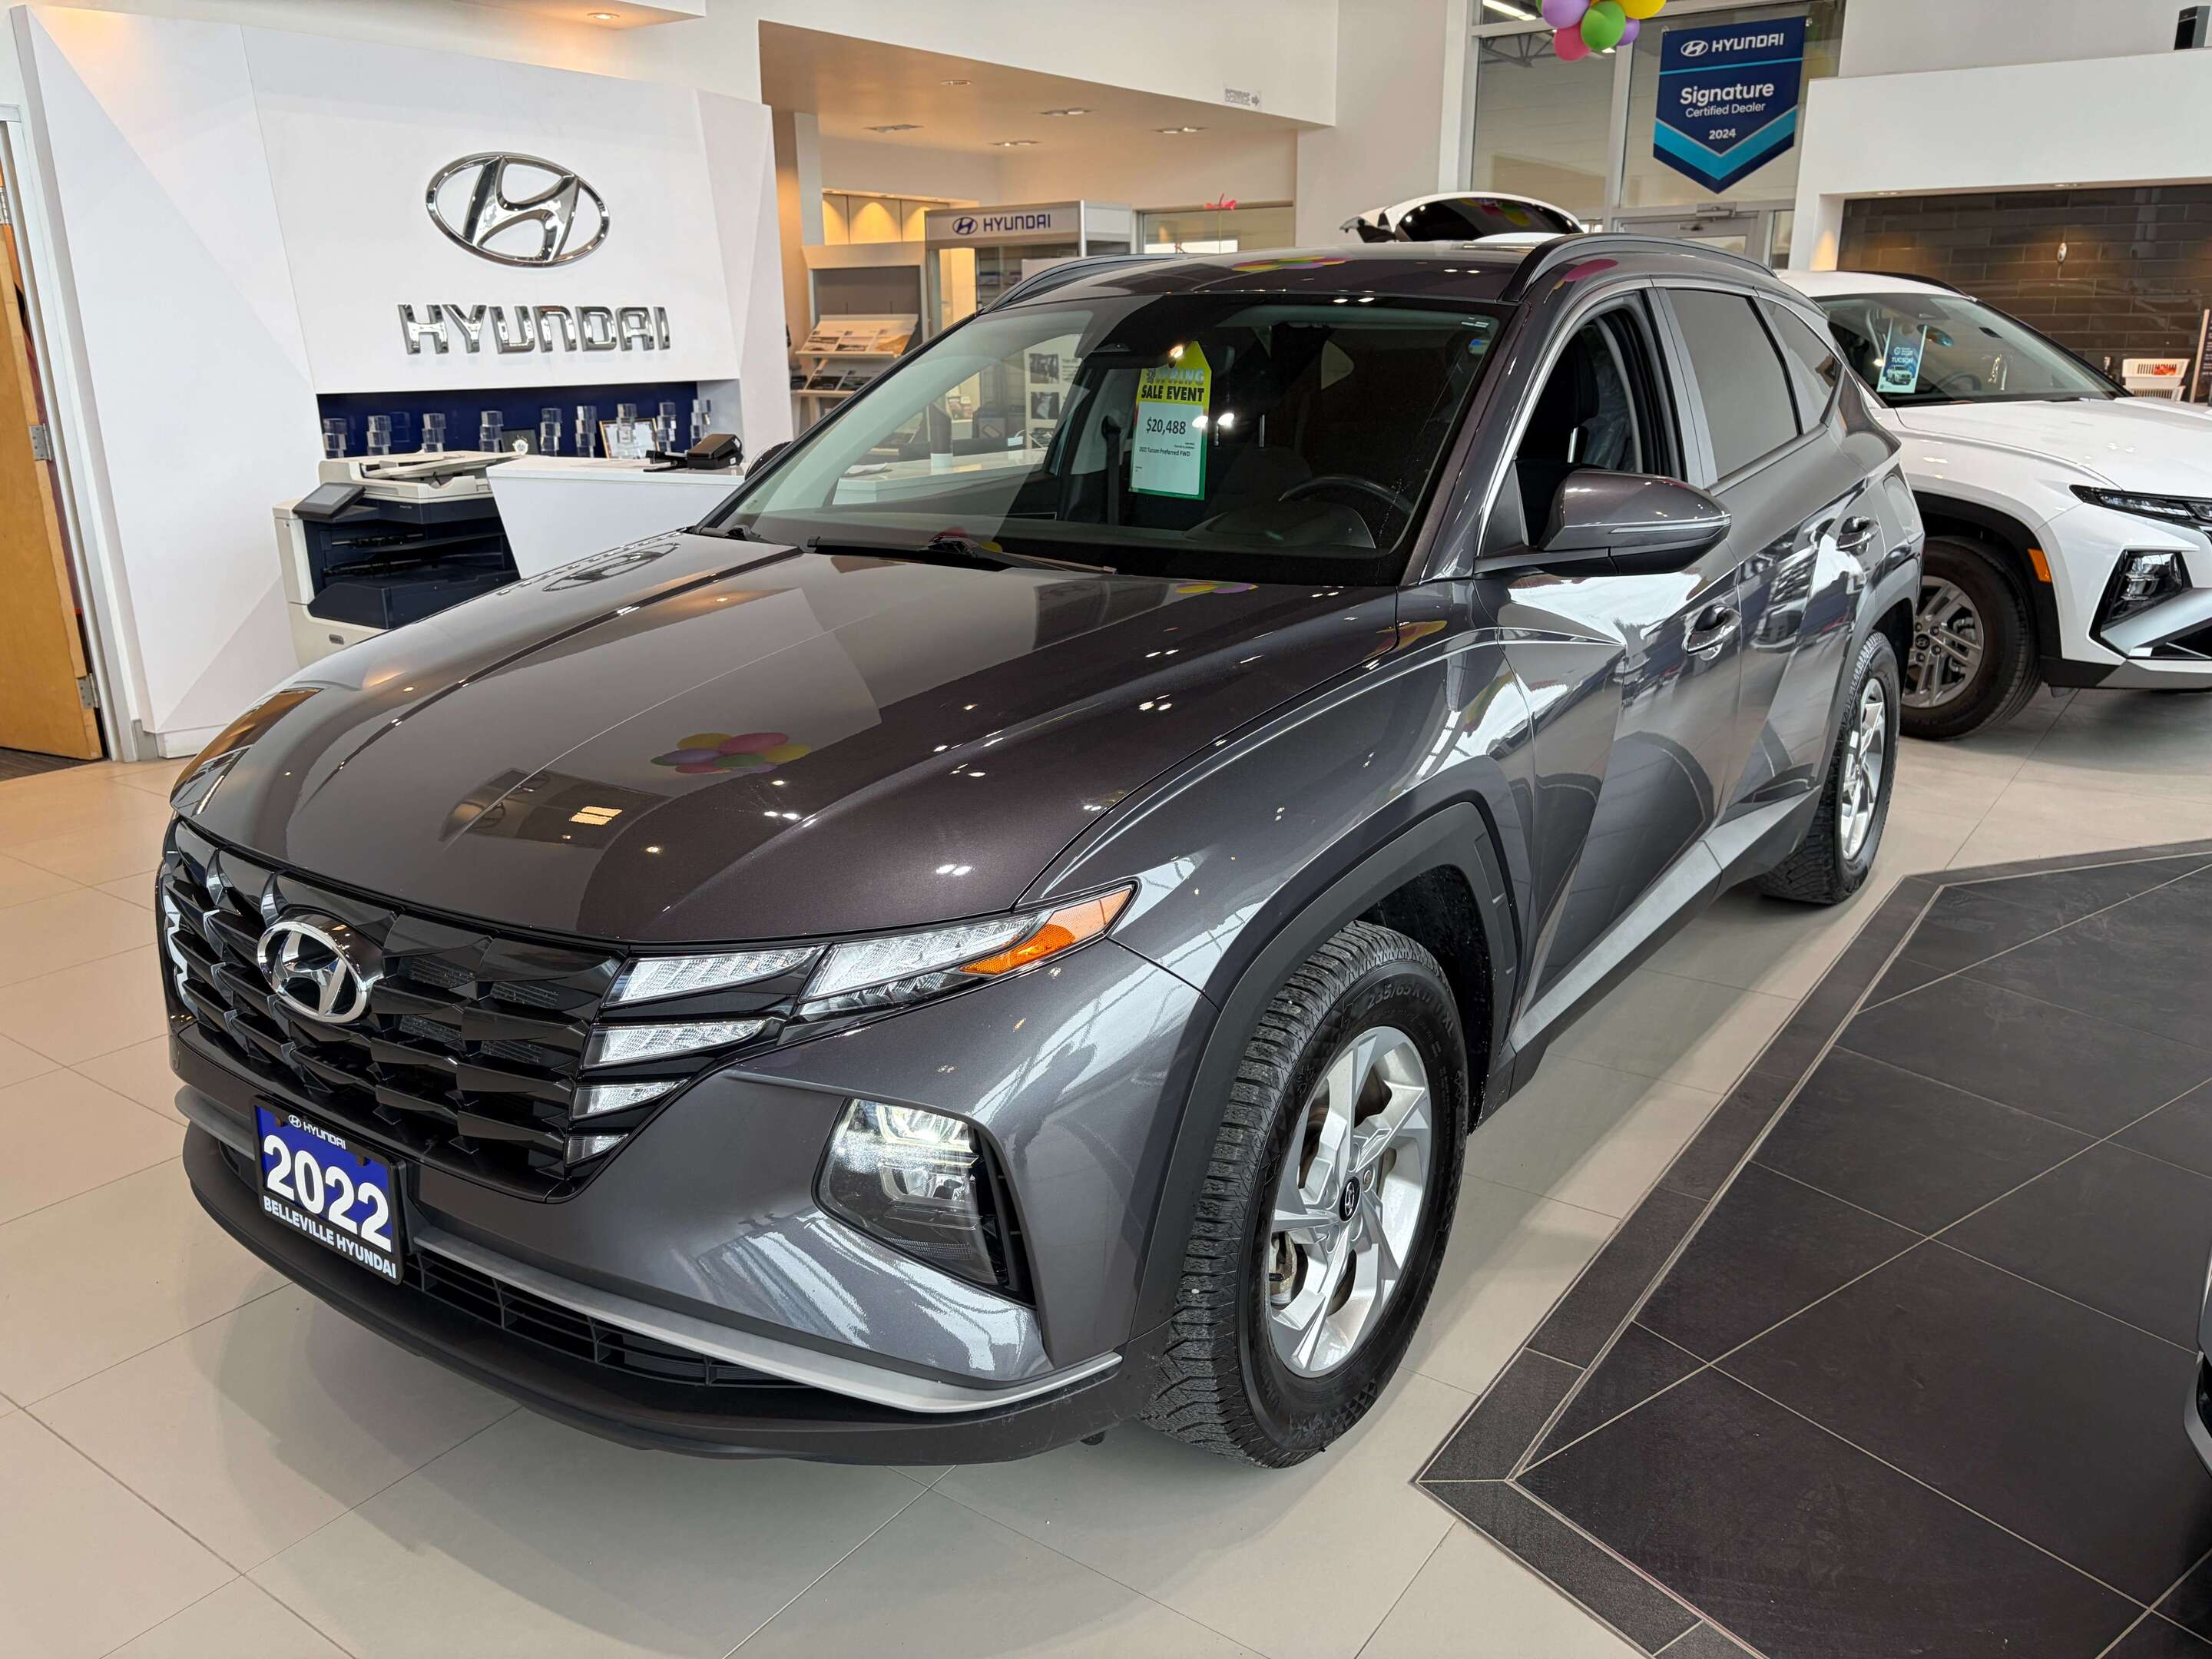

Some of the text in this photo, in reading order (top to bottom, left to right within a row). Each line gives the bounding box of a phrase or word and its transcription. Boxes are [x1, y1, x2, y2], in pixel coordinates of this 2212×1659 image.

[1712, 33, 1784, 52] HYUNDAI
[1680, 83, 1775, 106] Signature
[1685, 102, 1766, 118] Certified Dealer
[1708, 128, 1737, 140] 2024
[983, 214, 1051, 232] HYUNDAI
[398, 304, 671, 355] HYUNDAI
[1141, 385, 1205, 402] SALE EVENT
[1146, 416, 1187, 435] $20,488
[1160, 448, 1180, 456] Preferred
[303, 1122, 346, 1150] HYUNDAI
[263, 1134, 392, 1253] 2022
[263, 1195, 397, 1279] BELLEVILLE HYUNDAI
